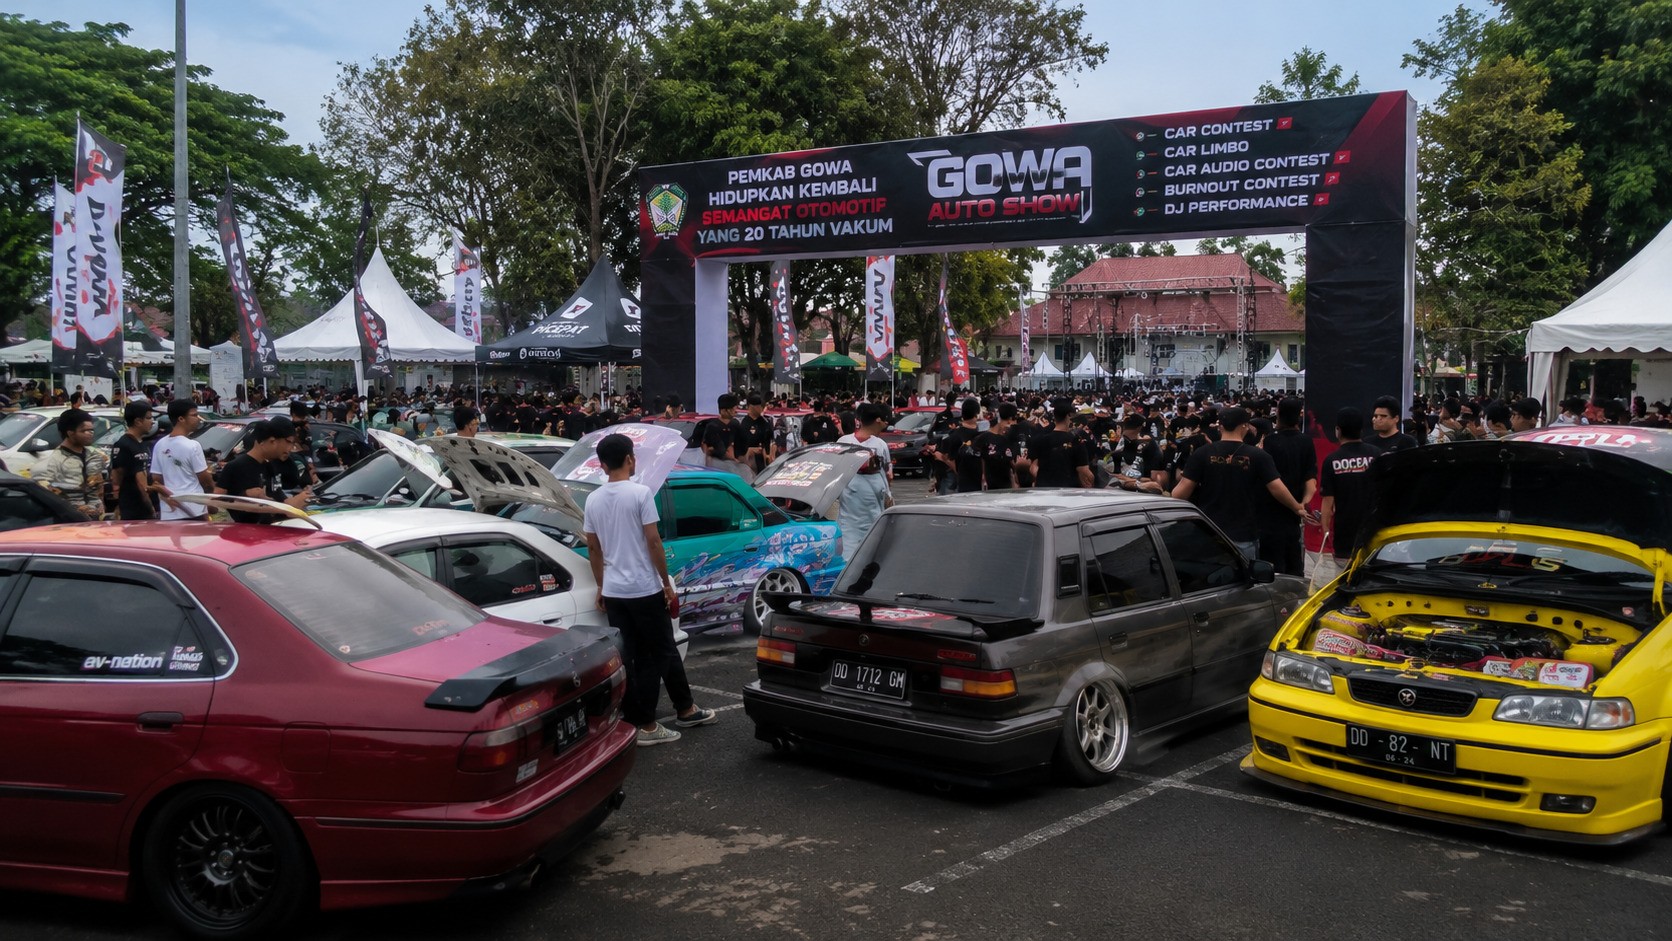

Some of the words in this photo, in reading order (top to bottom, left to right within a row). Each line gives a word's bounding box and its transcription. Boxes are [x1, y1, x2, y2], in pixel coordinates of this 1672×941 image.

[1164, 126, 1197, 140] CAR
[1201, 118, 1274, 136] CONTEST
[1164, 145, 1197, 159] CAR
[1201, 140, 1249, 156] LIMBO
[727, 166, 796, 185] PEMKAB
[800, 160, 853, 179] GOWA
[926, 145, 1093, 199] GOWA
[1164, 164, 1197, 178] CAR
[1200, 160, 1250, 175] AUDIO
[1254, 152, 1330, 171] CONTEST
[708, 186, 794, 206] HIDUPKAN
[799, 176, 878, 198] KEMBALI
[1164, 180, 1240, 197] BURNOUT
[1243, 173, 1320, 192] CONTEST
[701, 206, 792, 226] SEMANGAT
[796, 197, 888, 219] OTOMOTIF
[927, 197, 996, 222] AUTO
[1002, 192, 1081, 217] SHOW
[1164, 203, 1185, 215] DJ
[1188, 194, 1309, 214] PERFORMANCE
[697, 227, 740, 245] YANG
[744, 226, 765, 242] 20
[768, 221, 825, 240] TAHUN
[829, 217, 894, 237] VAKUM
[856, 666, 882, 685] 1712
[1350, 727, 1369, 746] DD
[1389, 734, 1407, 753] 82
[1431, 740, 1450, 761] NT
